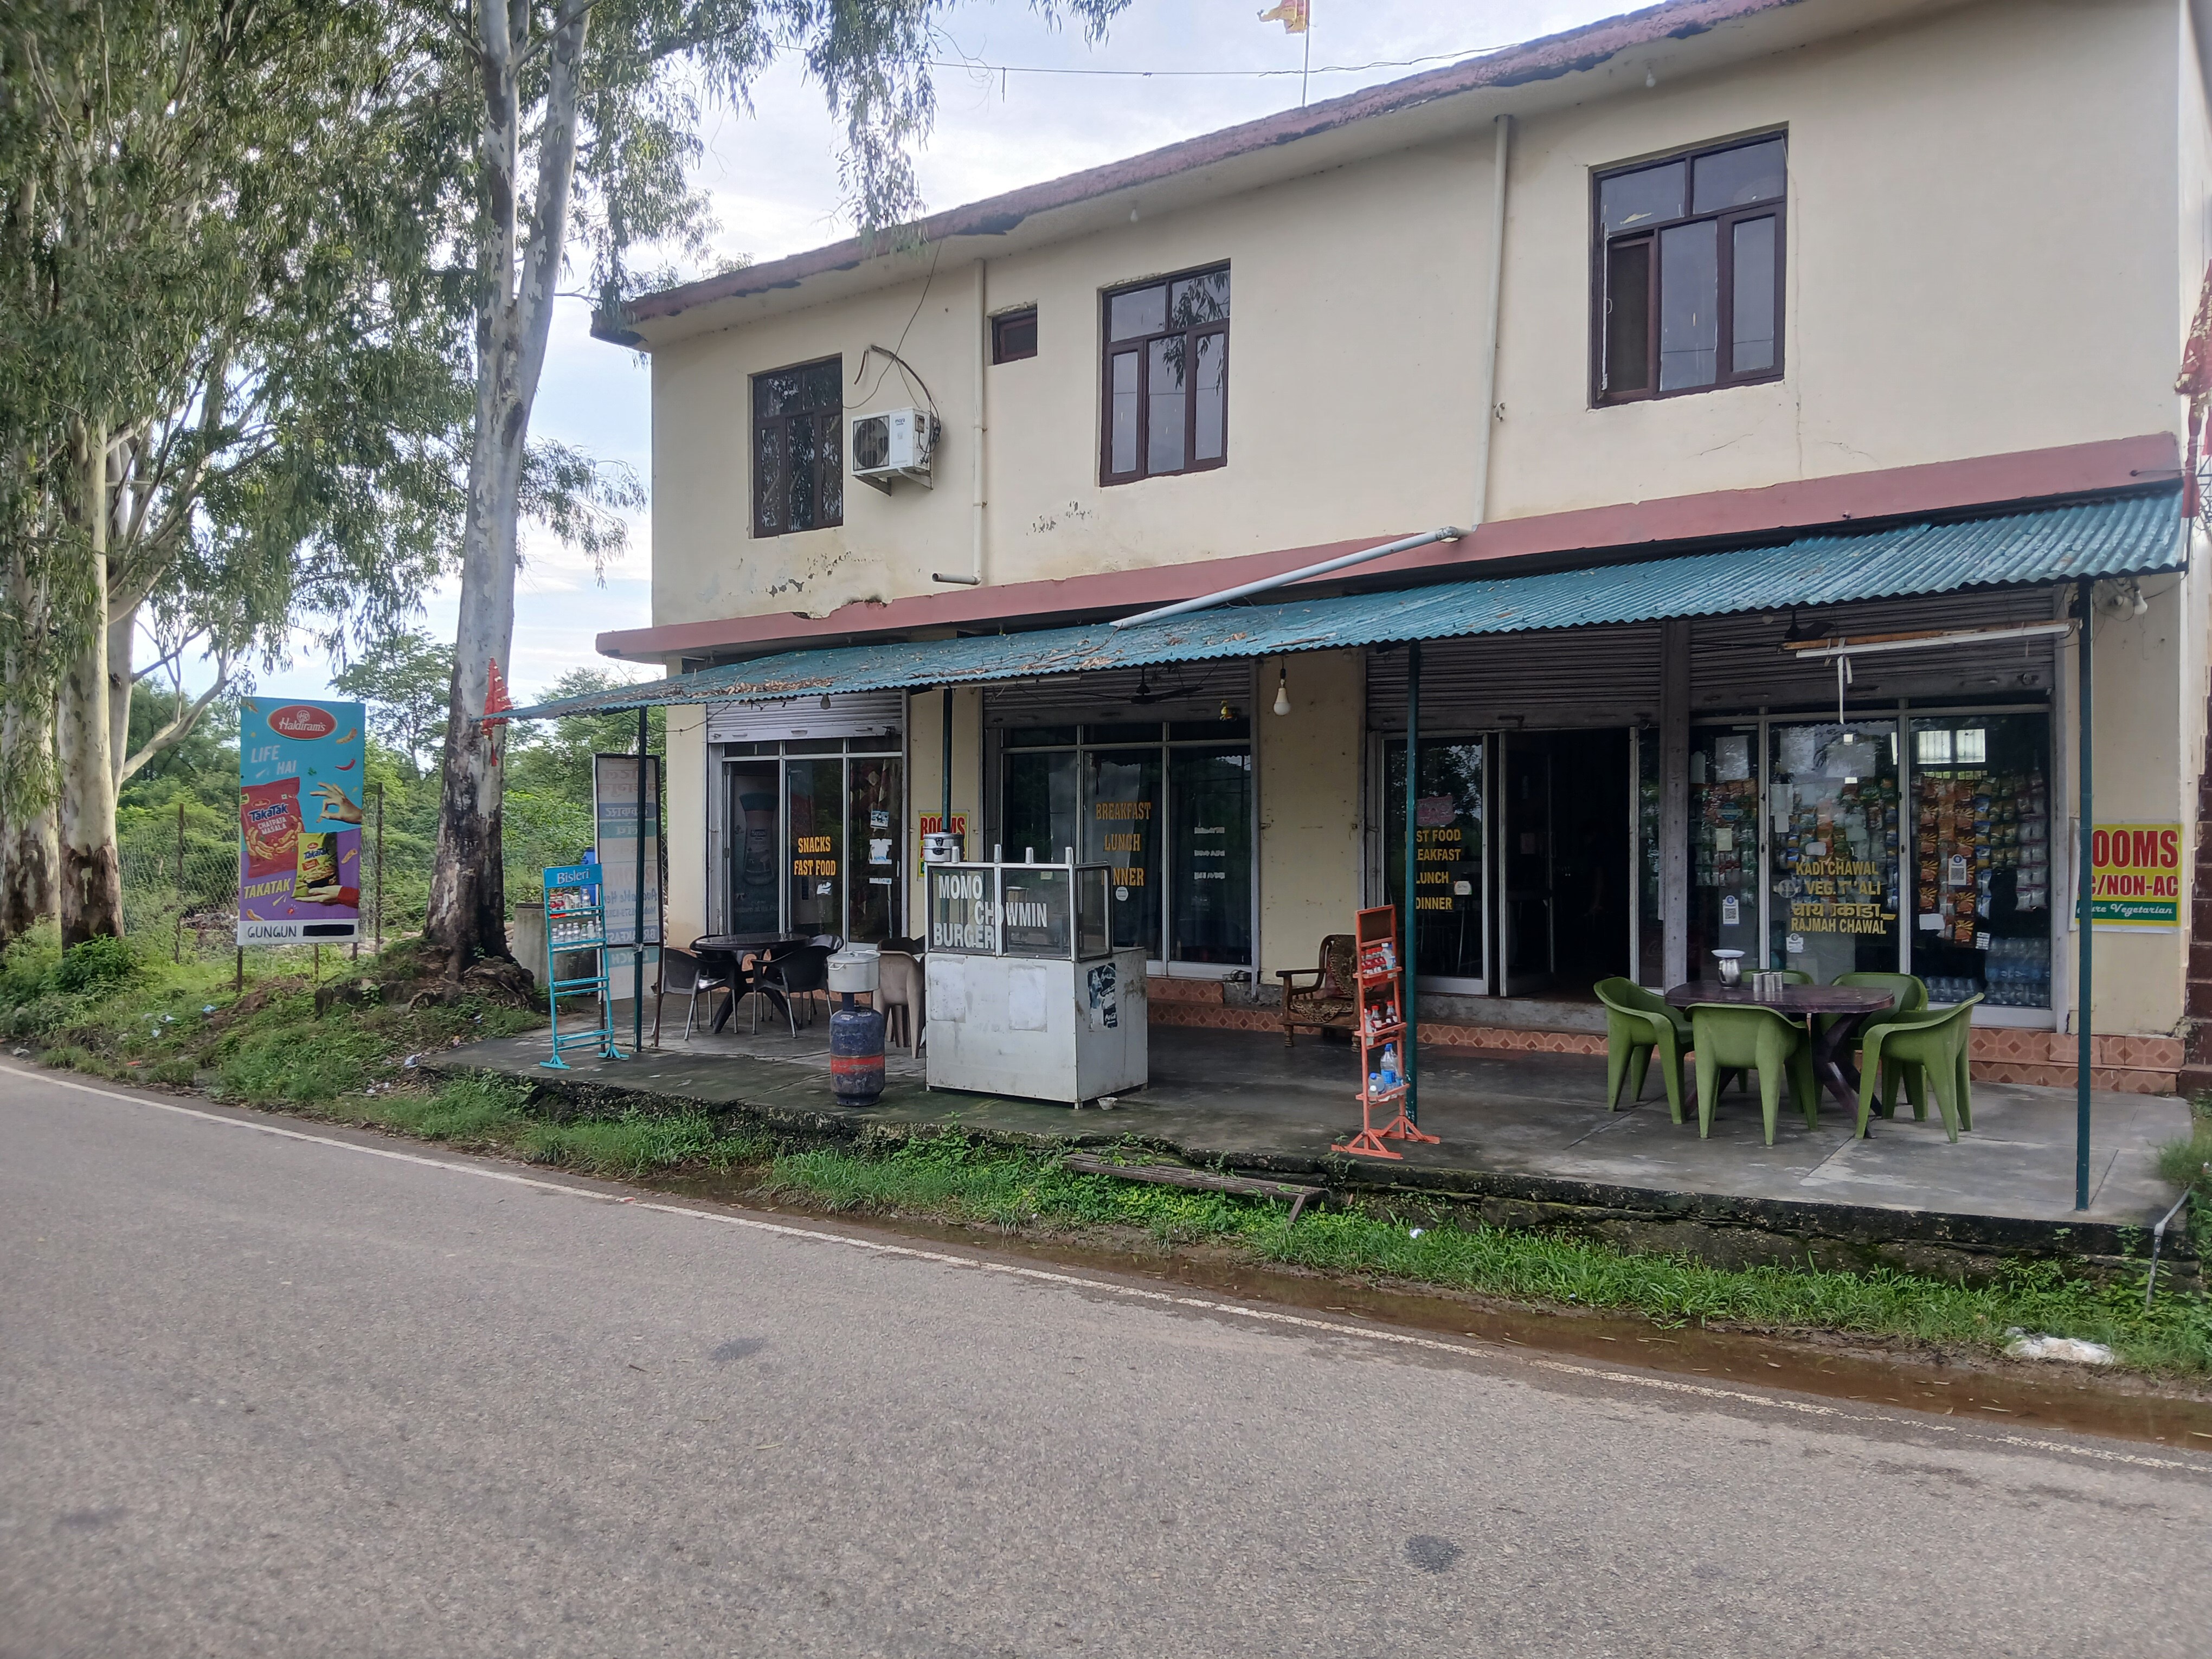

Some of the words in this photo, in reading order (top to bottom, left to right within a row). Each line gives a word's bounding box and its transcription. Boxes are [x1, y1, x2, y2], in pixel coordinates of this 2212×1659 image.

[279, 717, 326, 731] Haldiram's
[250, 745, 281, 763] LIFE
[276, 760, 297, 775] HAI
[1095, 802, 1152, 820] BREAKFAST
[258, 816, 287, 829] CHATPATA
[261, 823, 287, 835] MASALA
[1104, 833, 1141, 852] LUNCH
[1432, 829, 1462, 842] FOOD
[798, 836, 831, 853] SNACKS
[2092, 829, 2179, 868] OOMS
[556, 868, 590, 884] Bisleri
[794, 860, 813, 876] FAST
[815, 860, 837, 876] FOOD
[1828, 860, 1879, 876] CHAWAL
[244, 878, 292, 899] TAKATAK
[938, 874, 983, 899] MOMO
[1805, 880, 1836, 895] VEG.
[974, 901, 1047, 928] CHOWMIN
[1791, 903, 1825, 917] चाय
[2110, 903, 2173, 917] Vegetarian
[247, 925, 297, 938] GUNGUN
[1791, 917, 1836, 933] RAJMAH
[1840, 918, 1887, 934] CHAWAL
[934, 923, 995, 949] BURGER
